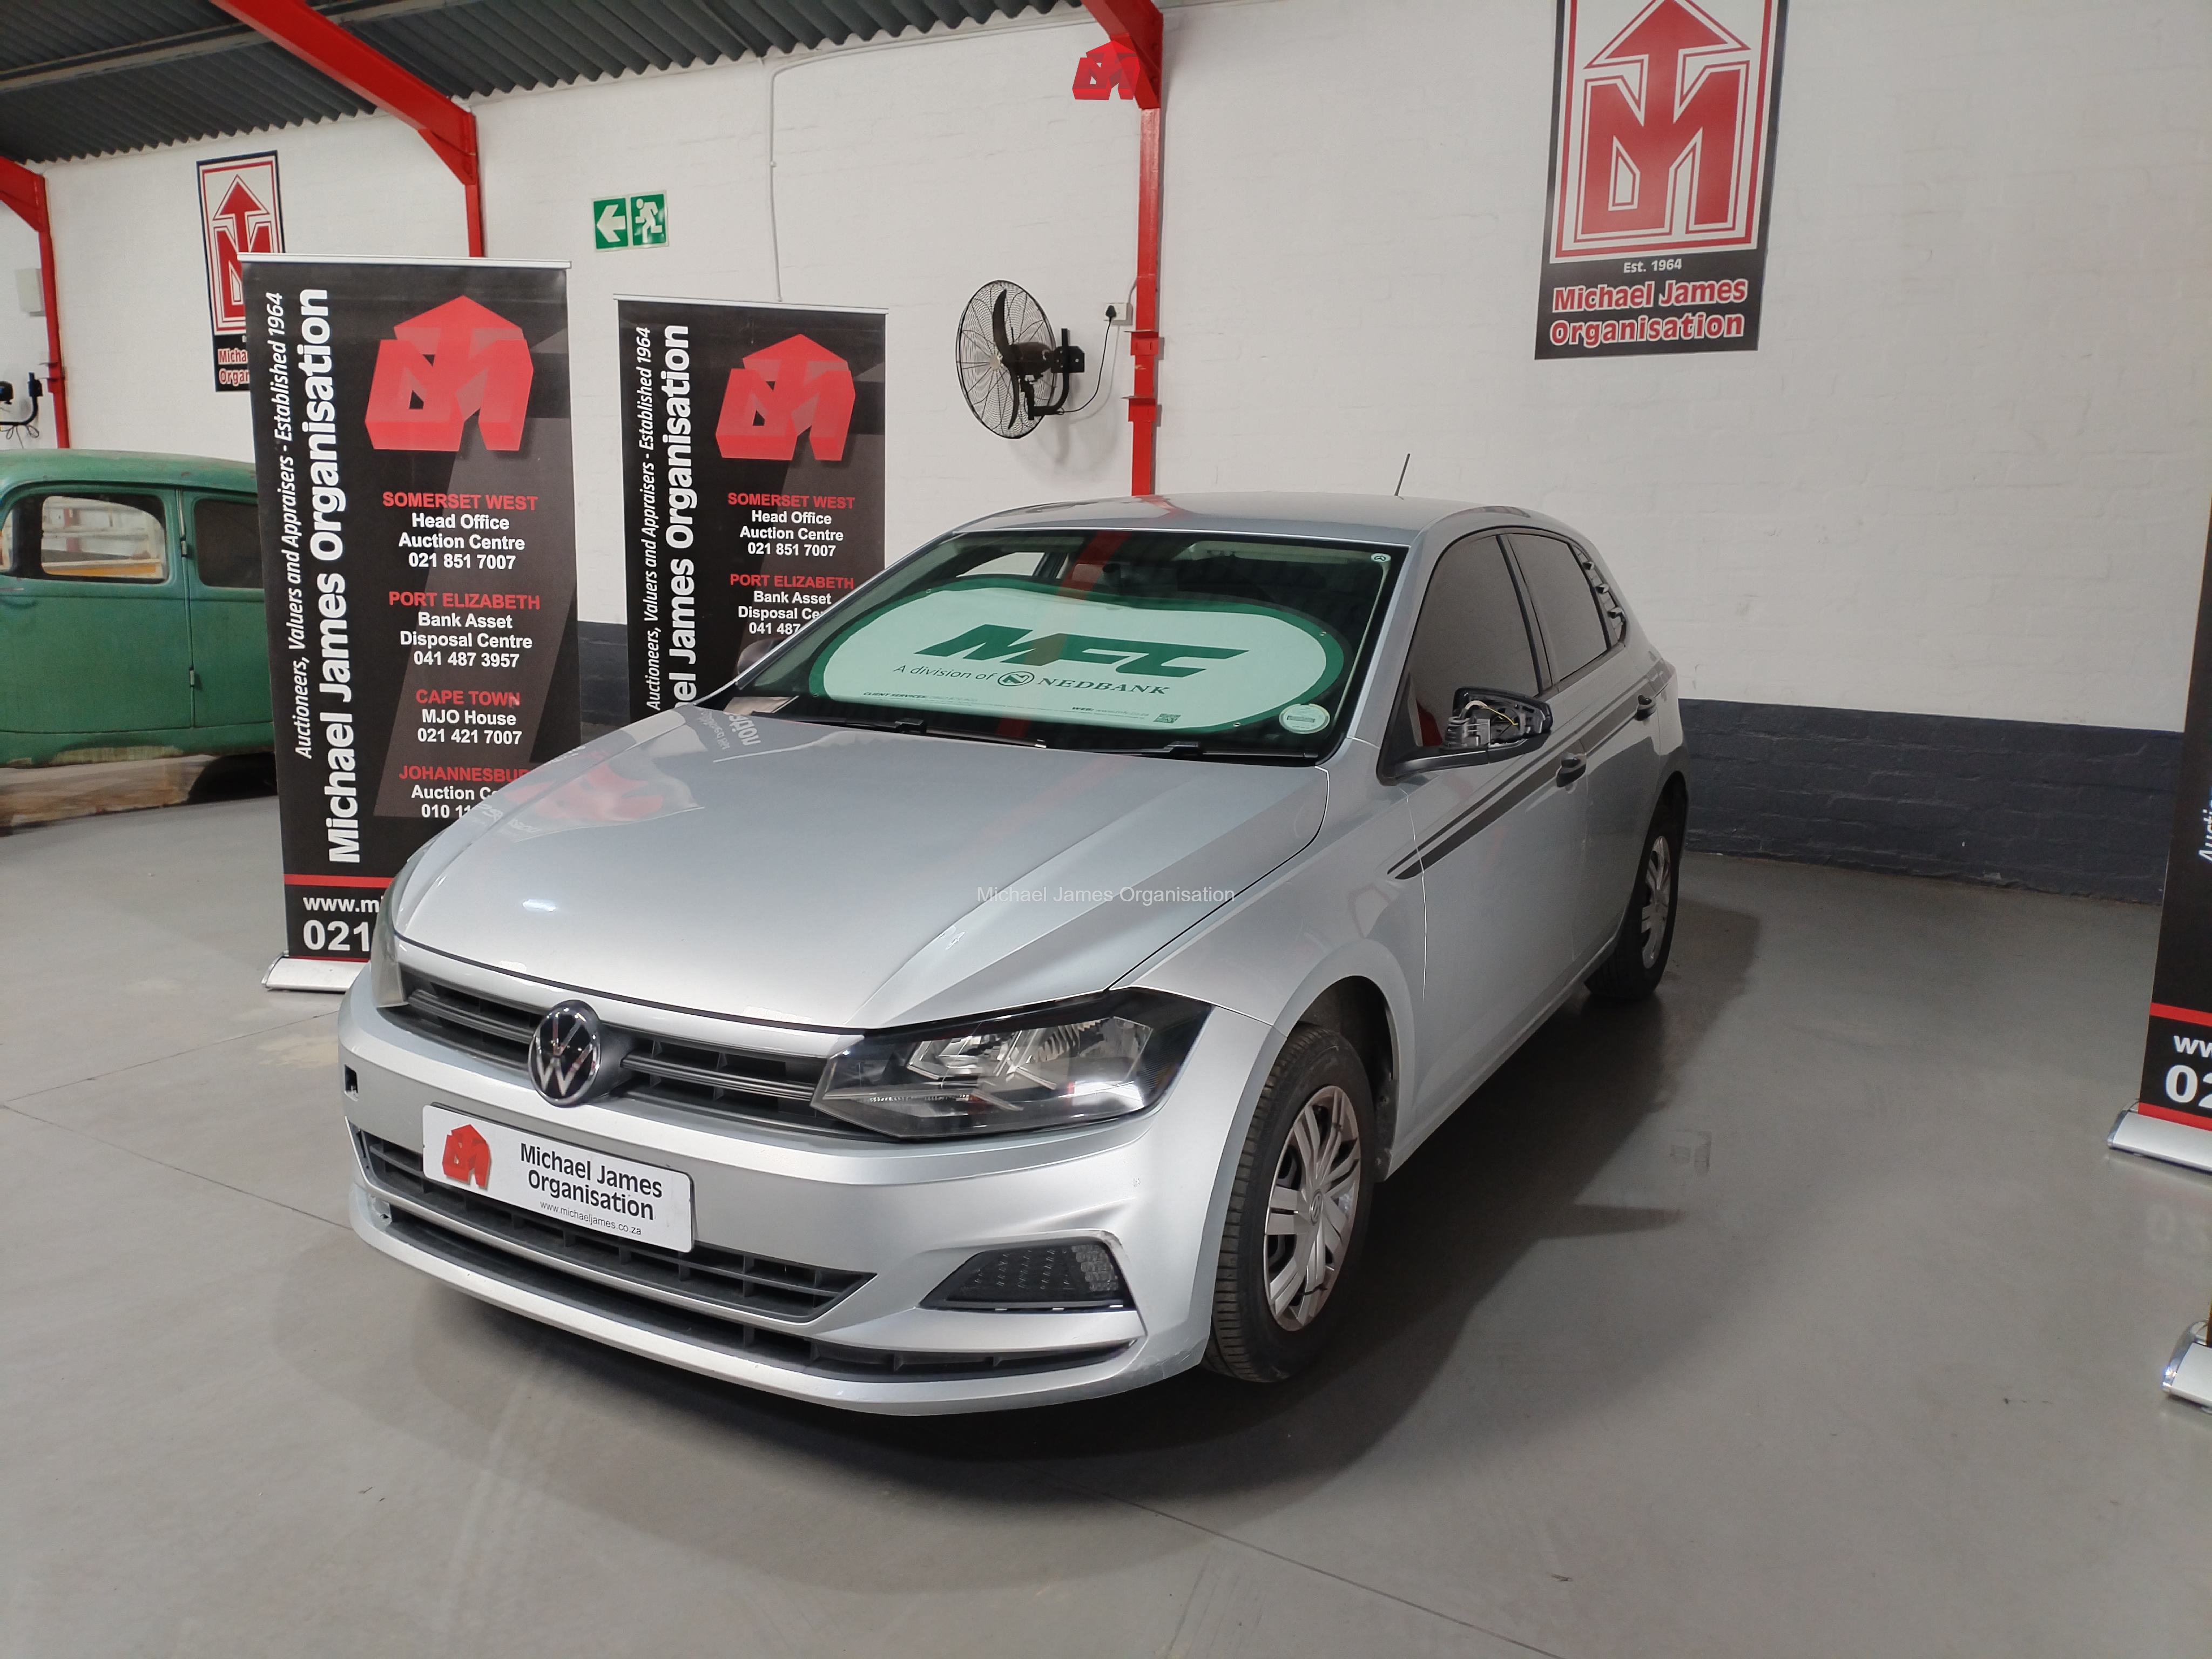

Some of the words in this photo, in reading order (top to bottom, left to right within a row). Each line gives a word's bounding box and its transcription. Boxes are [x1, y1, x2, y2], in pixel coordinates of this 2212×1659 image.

[1623, 261, 1647, 273] Est.
[1651, 259, 1682, 271] 1964
[1553, 281, 1655, 313] Michael
[1658, 279, 1748, 307] James
[265, 292, 285, 336] 1964
[1550, 312, 1745, 348] Organisation
[218, 347, 248, 365] Micha
[636, 327, 651, 363] 1964
[267, 340, 292, 441] Established
[636, 366, 654, 450] Established
[296, 289, 346, 561] Organisation
[660, 325, 698, 549] Organisation
[277, 455, 302, 548] Appraisers
[382, 491, 482, 509] SOMERSET
[484, 494, 538, 511] WEST
[639, 462, 659, 538] Appraisers
[727, 492, 810, 508] SOMERSET
[812, 495, 855, 509] WEST
[412, 512, 456, 529] Head
[460, 514, 510, 530] Office
[752, 509, 787, 523] Head
[791, 511, 832, 525] Office
[398, 532, 463, 549] Auction
[469, 534, 525, 550] Centre
[739, 525, 794, 539] Auction
[798, 528, 844, 541] Centre
[408, 552, 437, 568] 021
[443, 553, 471, 569] 851
[476, 554, 516, 570] 7007
[640, 538, 657, 568] and
[747, 542, 771, 555] 021
[775, 543, 799, 556] 851
[804, 544, 837, 557] 7007
[281, 549, 301, 584] and
[643, 570, 658, 621] Valuers
[730, 573, 771, 587] PORT
[773, 575, 854, 590] ELIZABETH
[388, 590, 438, 607] PORT
[442, 592, 541, 610] ELIZABETH
[669, 559, 696, 664] James
[753, 590, 789, 603] Bank
[792, 591, 832, 605] Asset
[286, 588, 305, 649] Valuers
[418, 611, 462, 627] Bank
[464, 613, 513, 629] Asset
[738, 605, 798, 621] Disposal
[316, 573, 352, 703] James
[400, 630, 473, 649] Disposal
[477, 632, 532, 649] Centre
[748, 622, 772, 635] 041
[414, 650, 441, 665] 041
[447, 651, 476, 666] 487
[481, 652, 520, 667] 3957
[914, 624, 1249, 678] MFC
[645, 627, 662, 711] Auctioneers,
[893, 665, 906, 673] A
[910, 666, 972, 678] division
[977, 672, 998, 682] of
[1037, 677, 1171, 694] NEDBANK
[292, 657, 312, 759] Auctioneers,
[415, 689, 464, 705] CAPE
[468, 690, 521, 707] TOWN
[422, 709, 460, 724] MJO
[464, 710, 517, 726] House
[417, 727, 445, 743] 021
[450, 729, 478, 744] 421
[484, 730, 522, 745] 7007
[320, 712, 360, 863] Michael
[411, 784, 475, 800] Auction
[421, 804, 450, 818] 010
[303, 895, 383, 913] www.m
[304, 920, 369, 952] 021
[521, 1143, 591, 1181] Michael
[597, 1165, 663, 1198] James
[528, 1169, 654, 1220] Organisation
[540, 1201, 642, 1235] www.michaeljames.co.za
